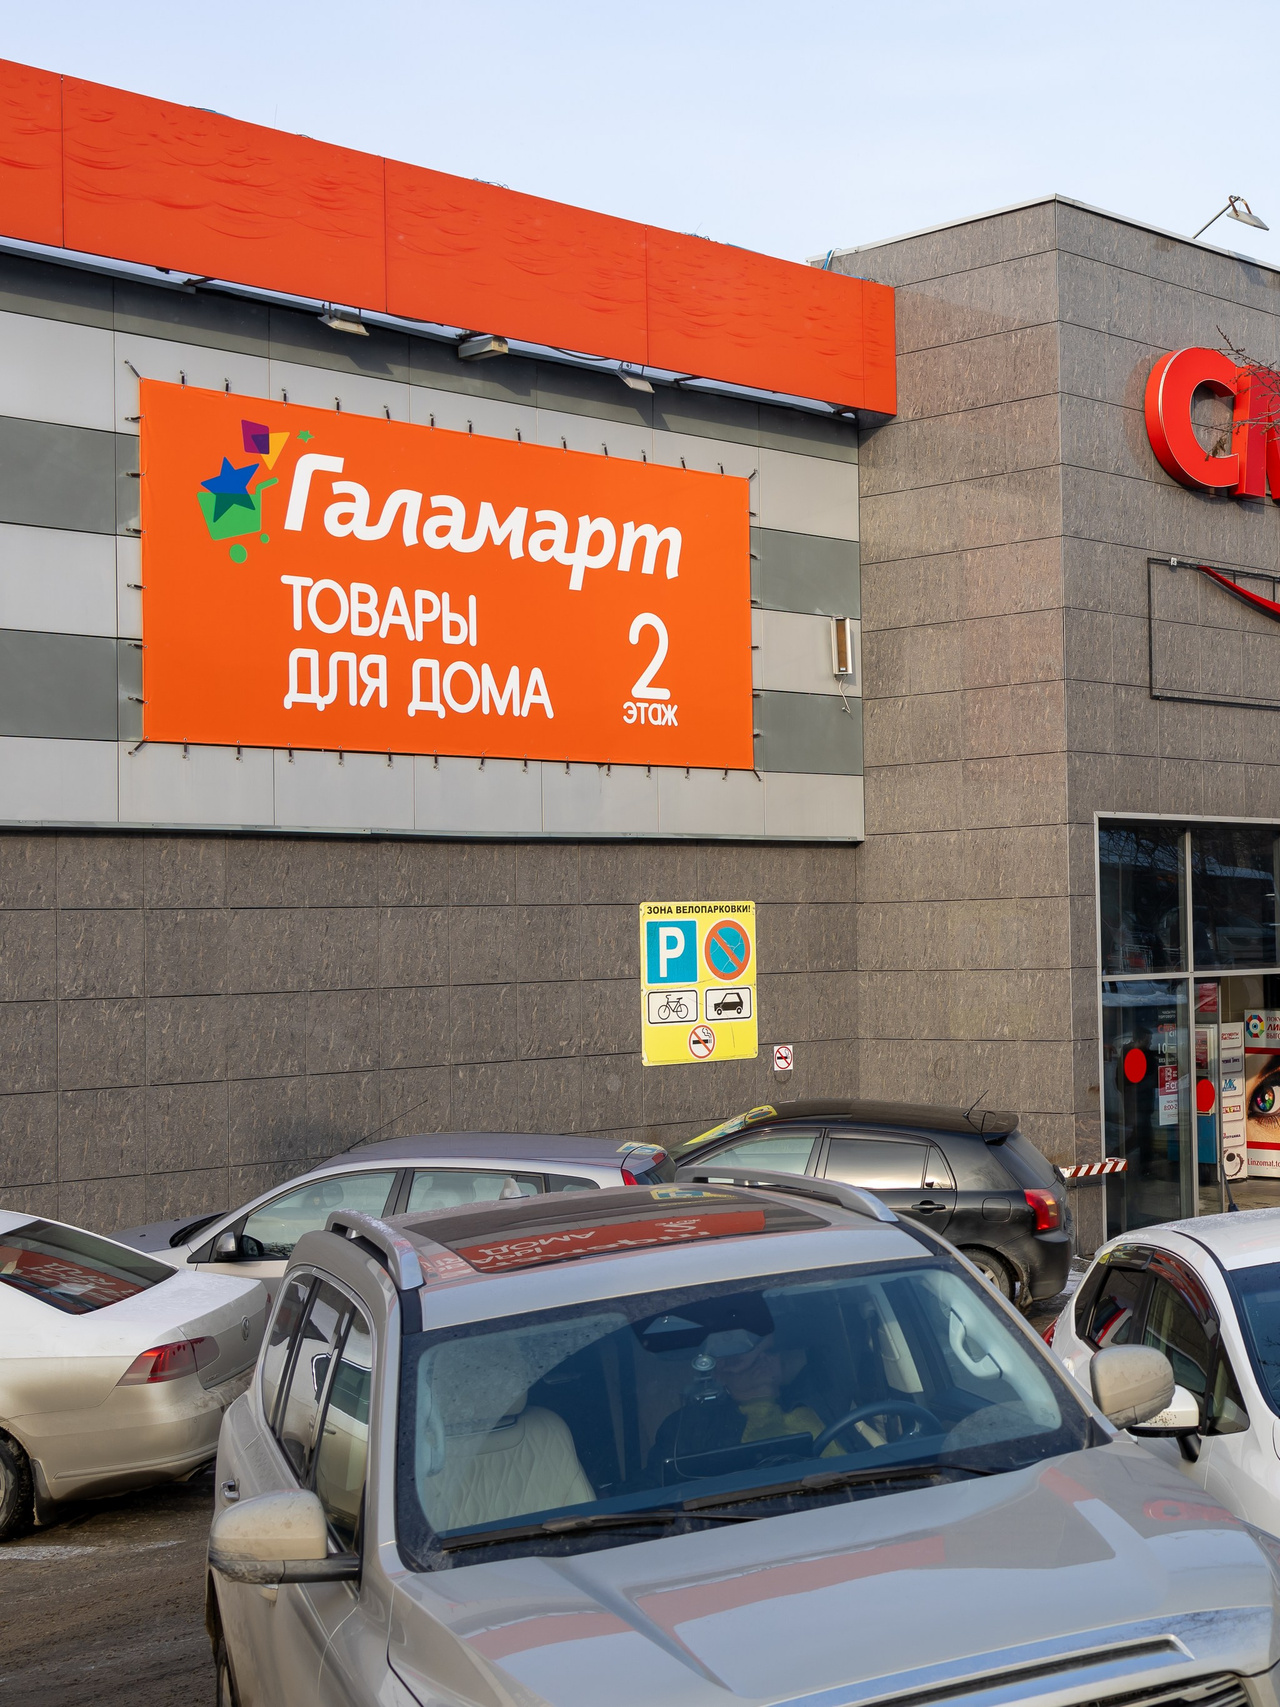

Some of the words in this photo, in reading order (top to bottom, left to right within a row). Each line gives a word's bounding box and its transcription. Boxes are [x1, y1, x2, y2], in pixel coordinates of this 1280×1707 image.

[283, 453, 682, 591] Галамарт
[281, 574, 477, 647] ТОВАРЫ
[283, 647, 388, 711] ДЛЯ
[407, 657, 554, 720] ДОМА
[628, 612, 671, 700] 2
[647, 906, 673, 915] ЗОНА
[675, 904, 751, 914] ВЕЛОПАРКОВКИ!
